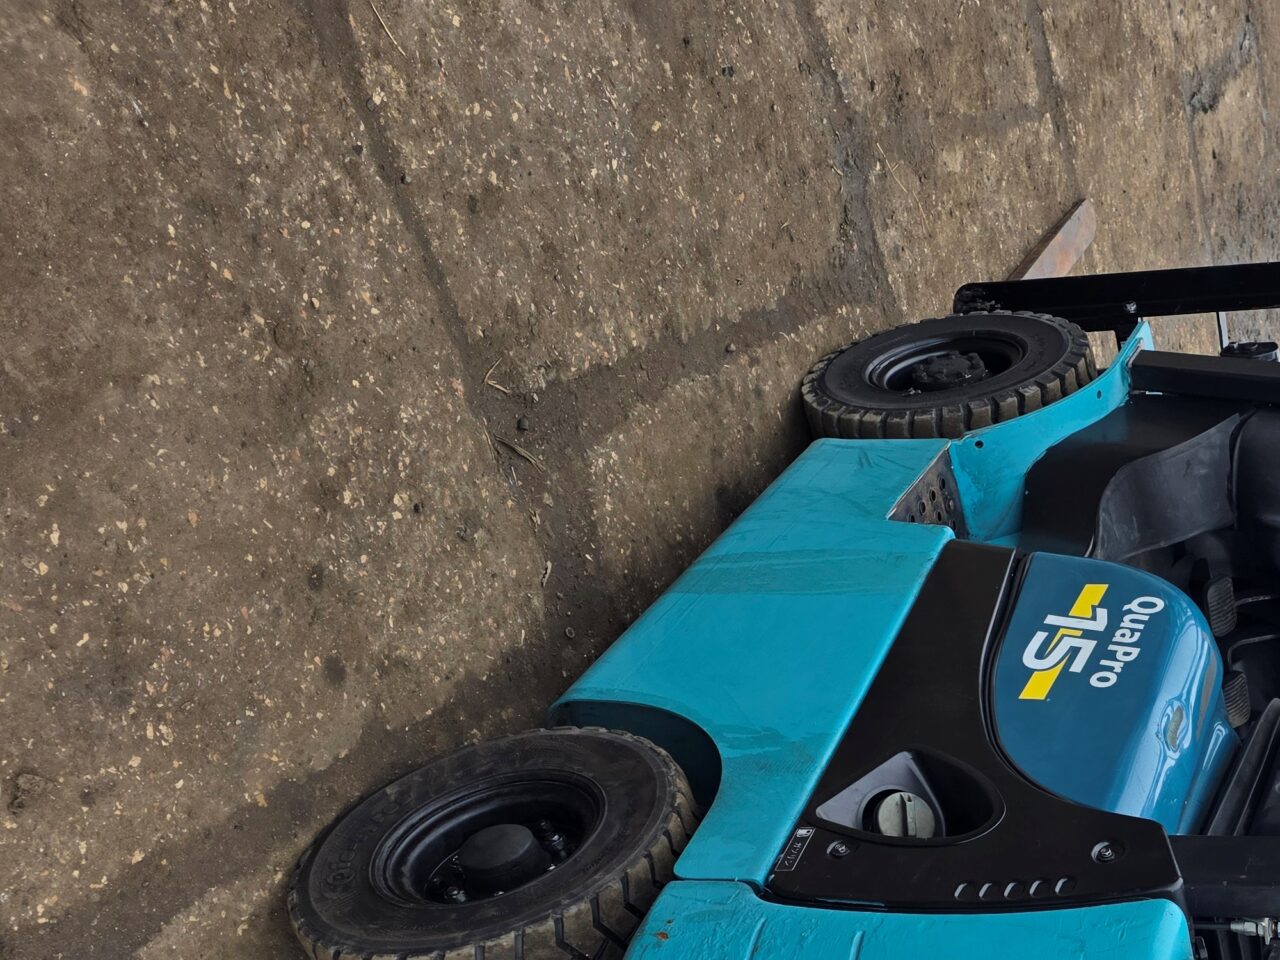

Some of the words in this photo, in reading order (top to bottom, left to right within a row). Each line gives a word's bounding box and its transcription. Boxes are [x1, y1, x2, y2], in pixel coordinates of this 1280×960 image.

[1022, 607, 1108, 674] 15
[1089, 596, 1165, 688] QuaPro
[784, 842, 802, 866] ガソリン
